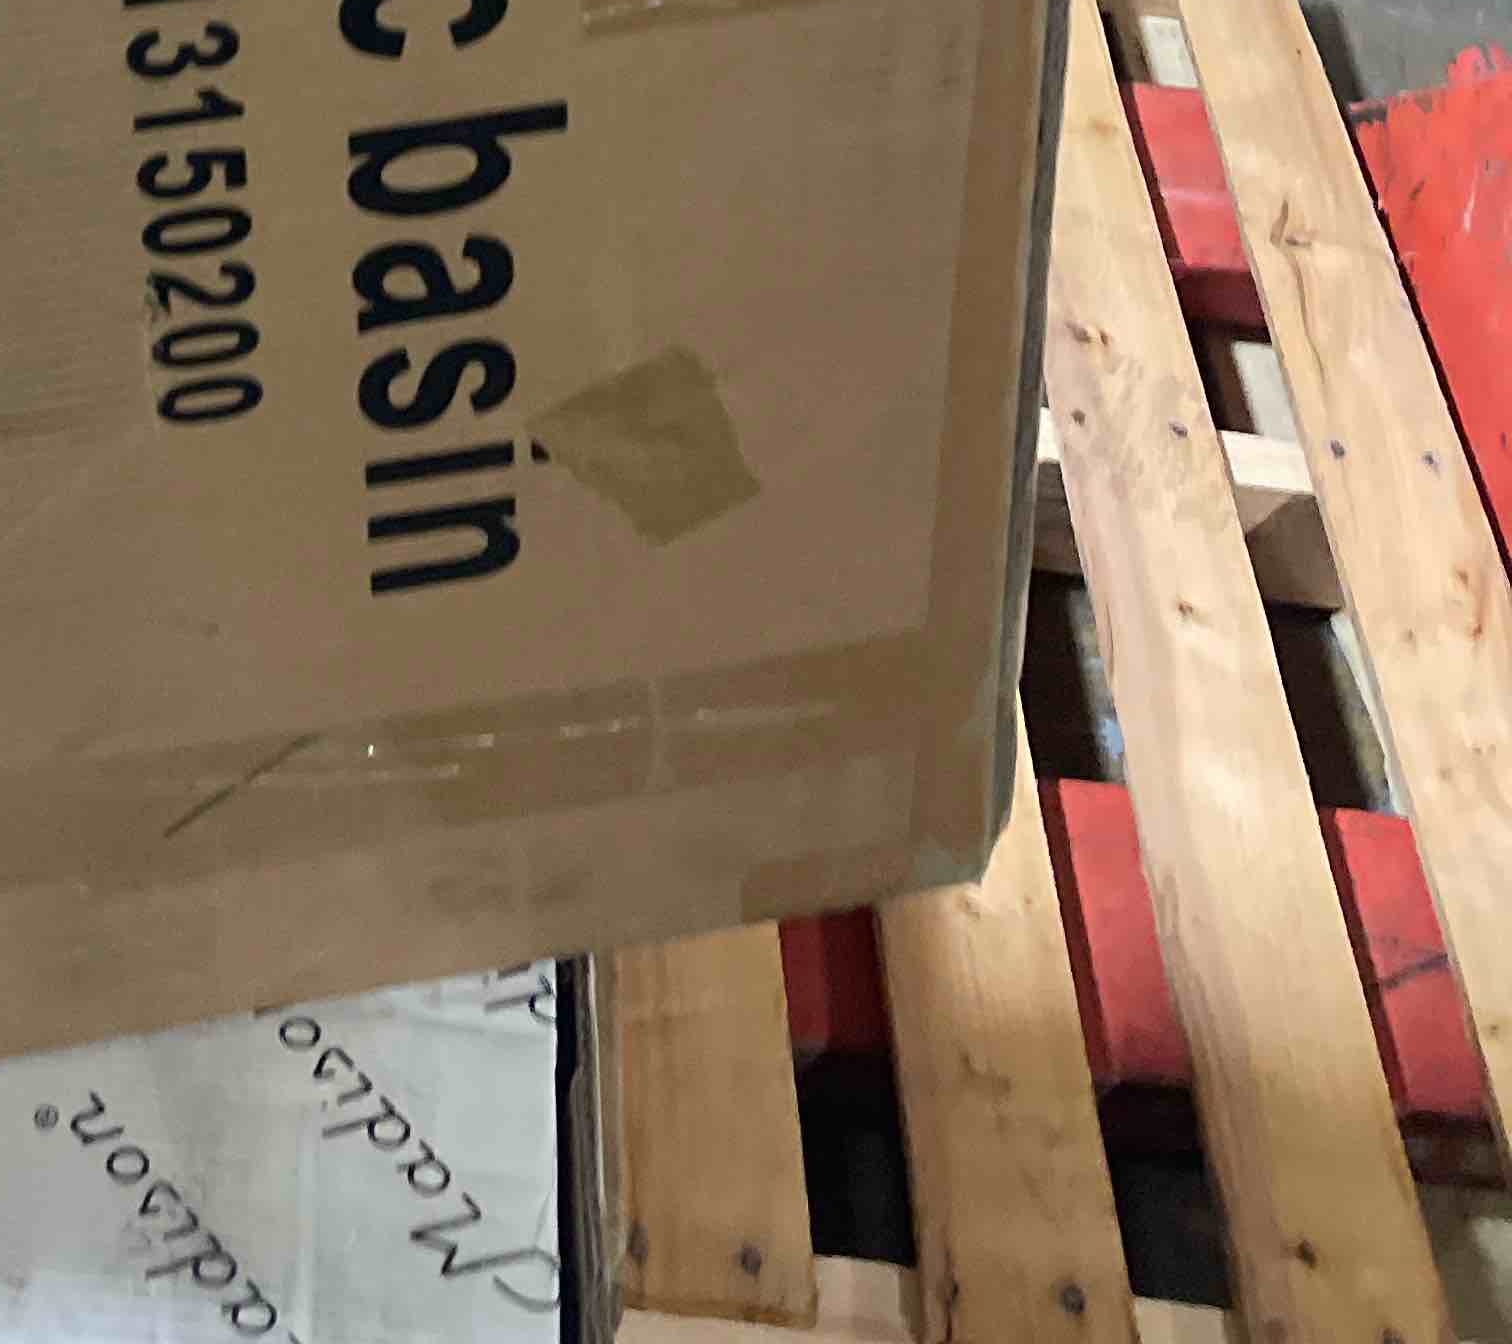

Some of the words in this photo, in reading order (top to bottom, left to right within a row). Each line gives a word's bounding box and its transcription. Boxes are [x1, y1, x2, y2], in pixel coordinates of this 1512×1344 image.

[347, 99, 569, 598] basin
[69, 1090, 300, 1344] adison
[255, 1004, 560, 1312] Madiso
